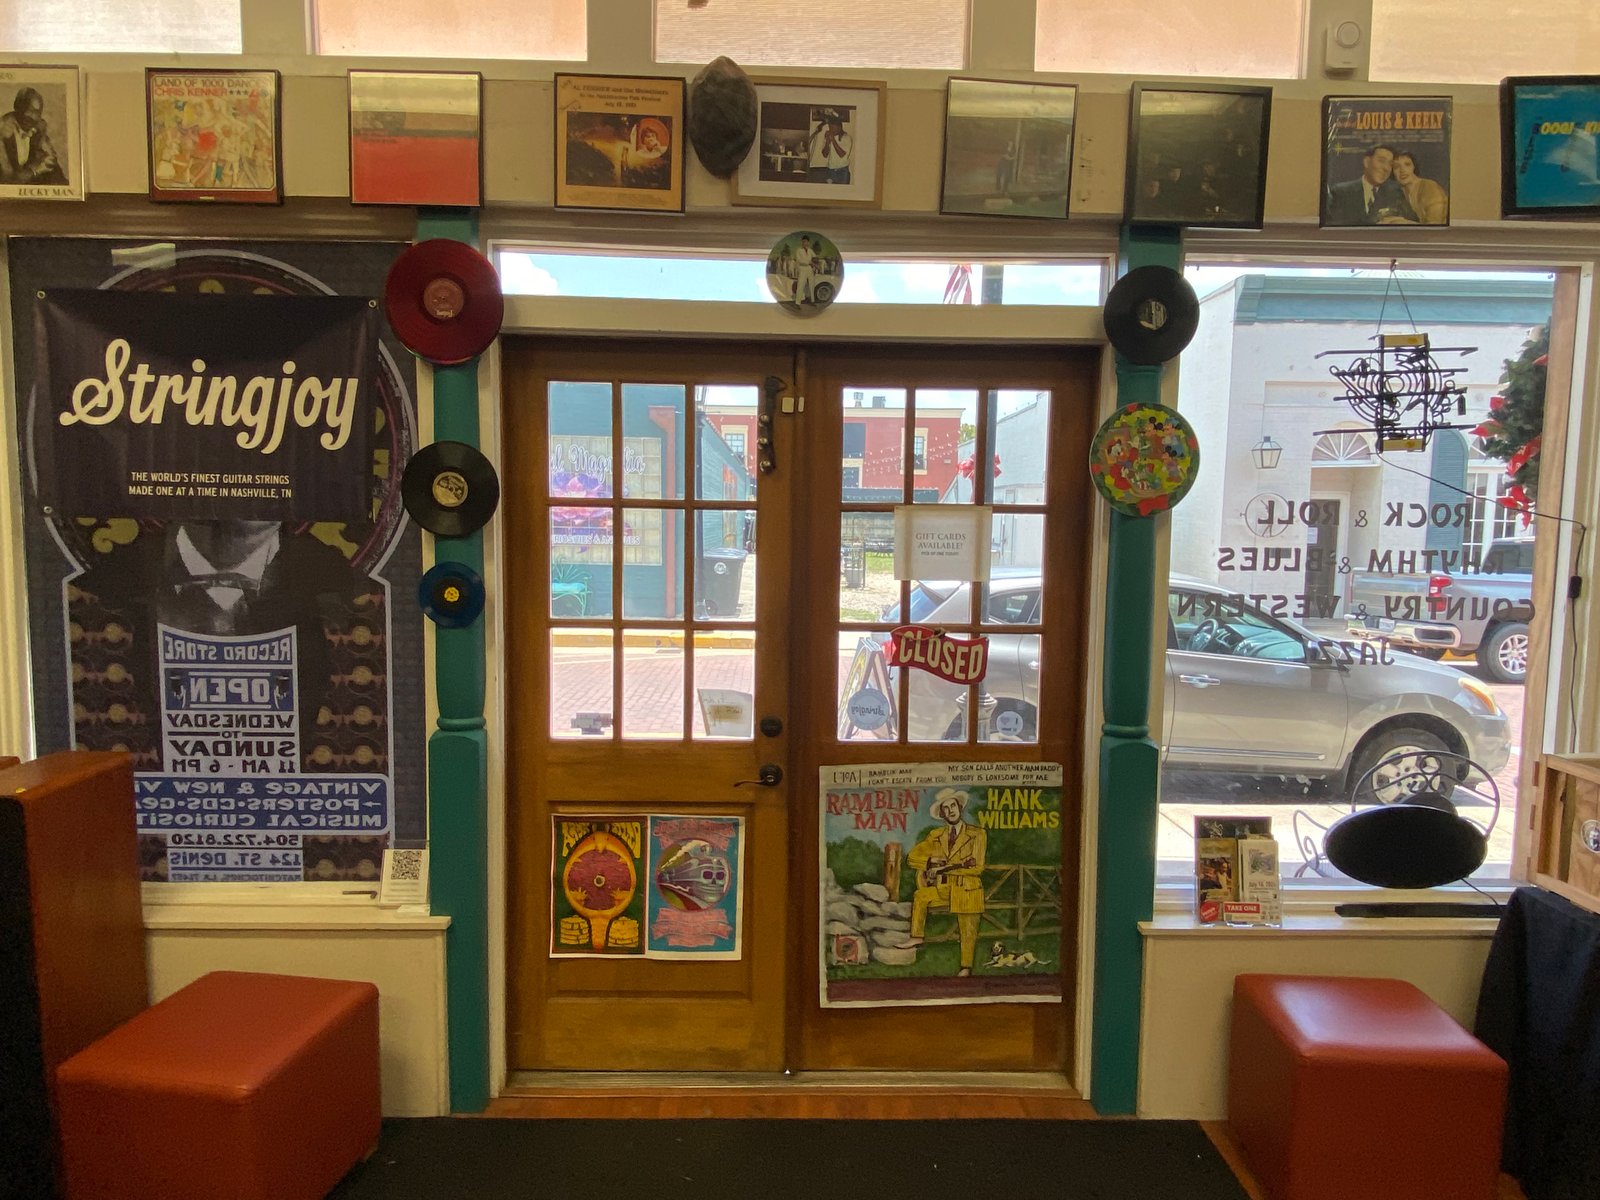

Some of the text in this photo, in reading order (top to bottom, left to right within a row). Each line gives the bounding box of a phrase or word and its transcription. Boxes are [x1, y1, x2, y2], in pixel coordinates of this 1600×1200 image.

[154, 78, 181, 87] LAND
[184, 79, 197, 87] OF
[154, 88, 228, 97] CHRIS KENNER
[1356, 111, 1392, 129] LOUIS
[1394, 112, 1404, 129] &
[1406, 111, 1444, 129] KEELY
[59, 338, 359, 455] Stringjoy
[131, 472, 289, 485] THE WORLD'S FINEST GUITAR STRINGS
[128, 485, 292, 499] MADE ONE AT A TIME IN NASHVILLE, TN
[915, 532, 966, 541] GIFT CARDS
[918, 541, 963, 550] AVAILABLE!
[900, 630, 984, 680] CLOSED
[987, 788, 1043, 811] HANK
[854, 812, 908, 833] MAN
[978, 810, 1060, 829] WILLIAMS
